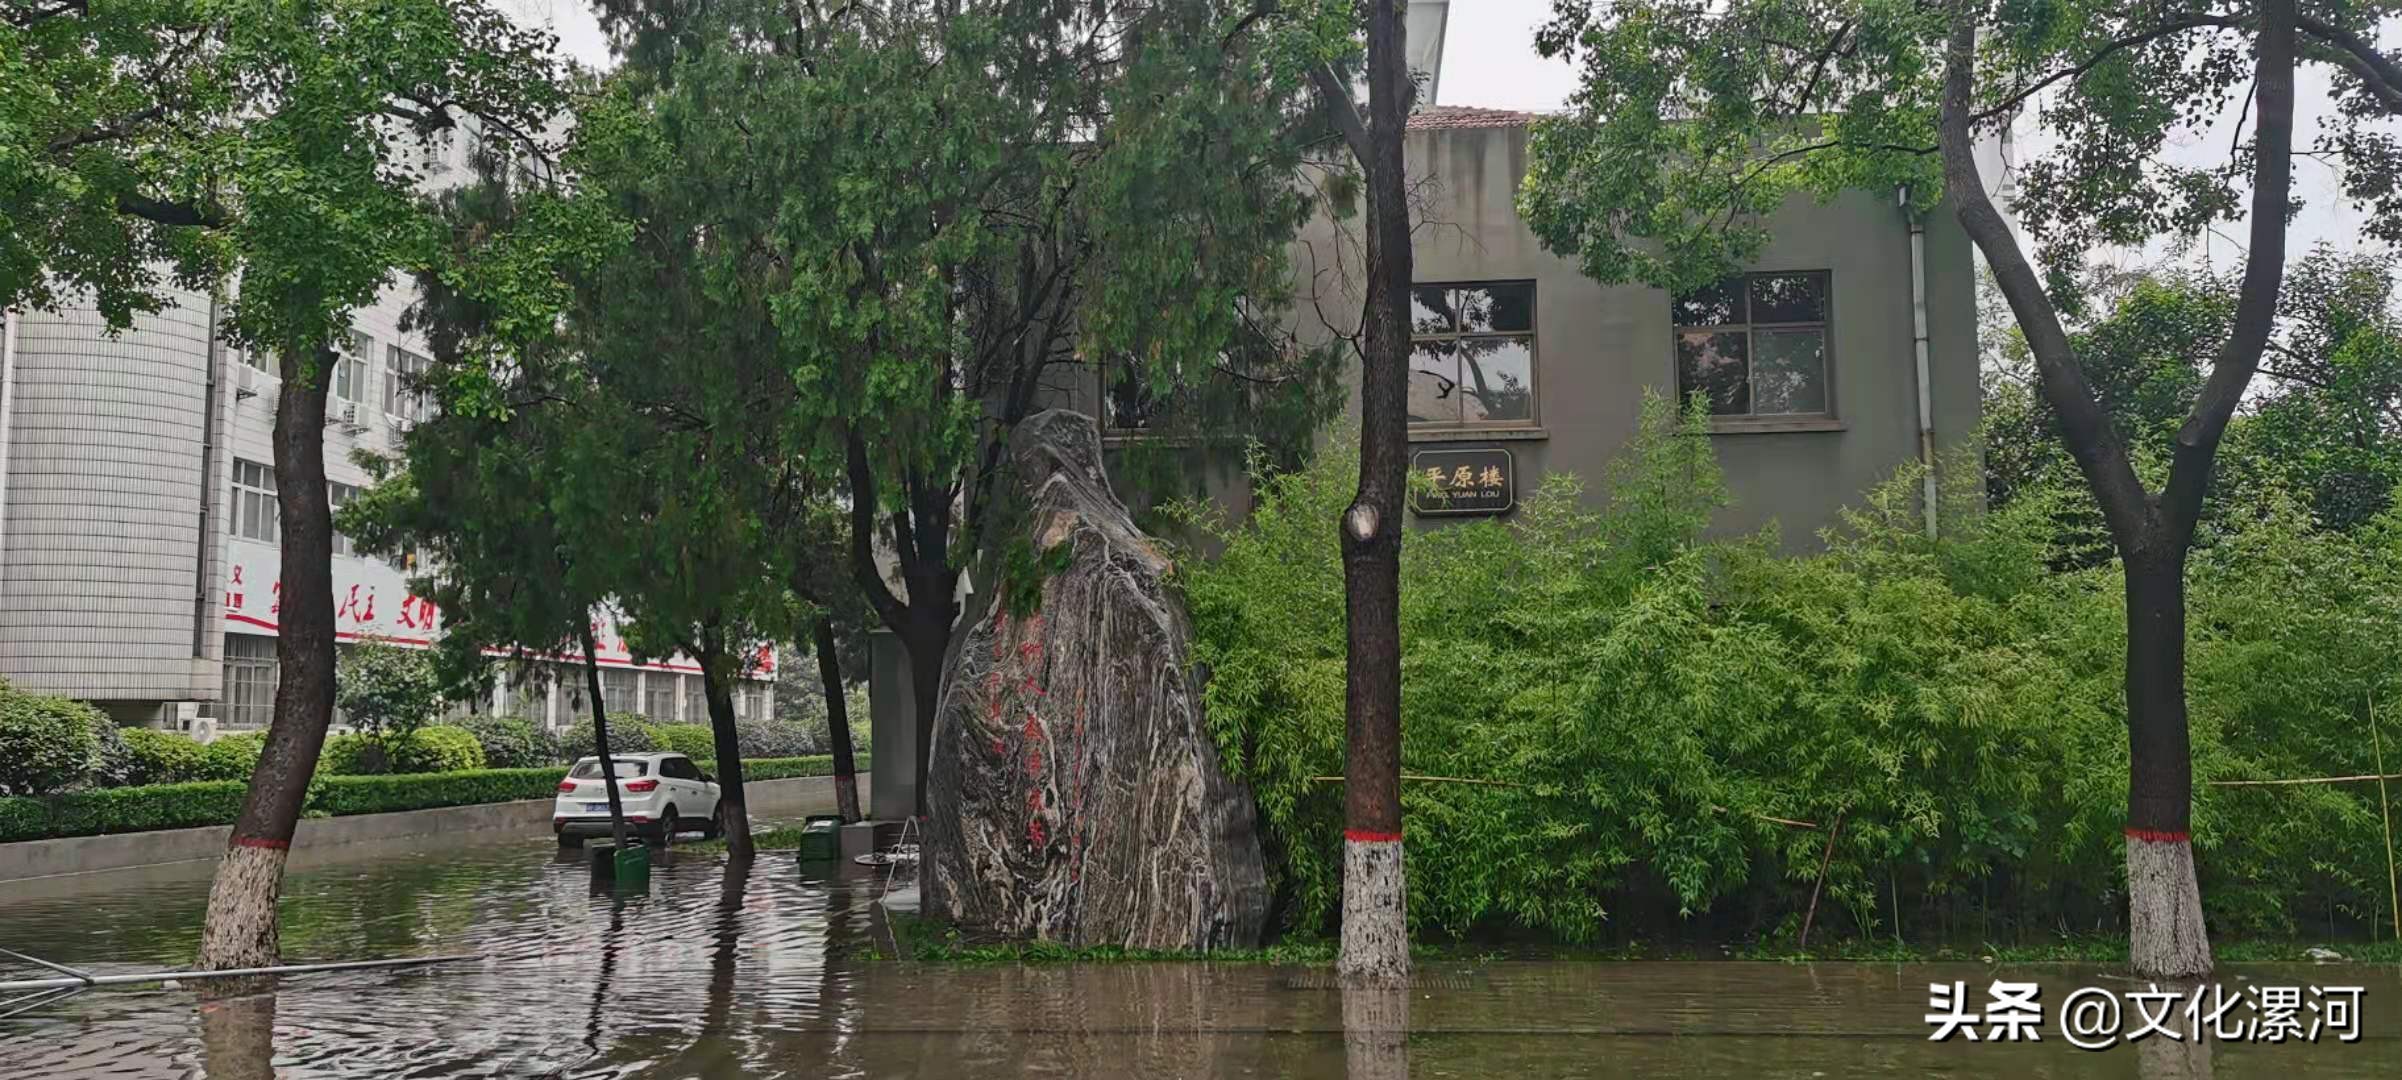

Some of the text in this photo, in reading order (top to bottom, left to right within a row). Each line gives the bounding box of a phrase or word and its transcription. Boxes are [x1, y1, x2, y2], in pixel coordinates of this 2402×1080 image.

[1424, 465, 1504, 488] 平原楼
[1452, 490, 1477, 498] YUAN
[1480, 489, 1500, 498] LOU
[338, 584, 437, 630] 民主 文明
